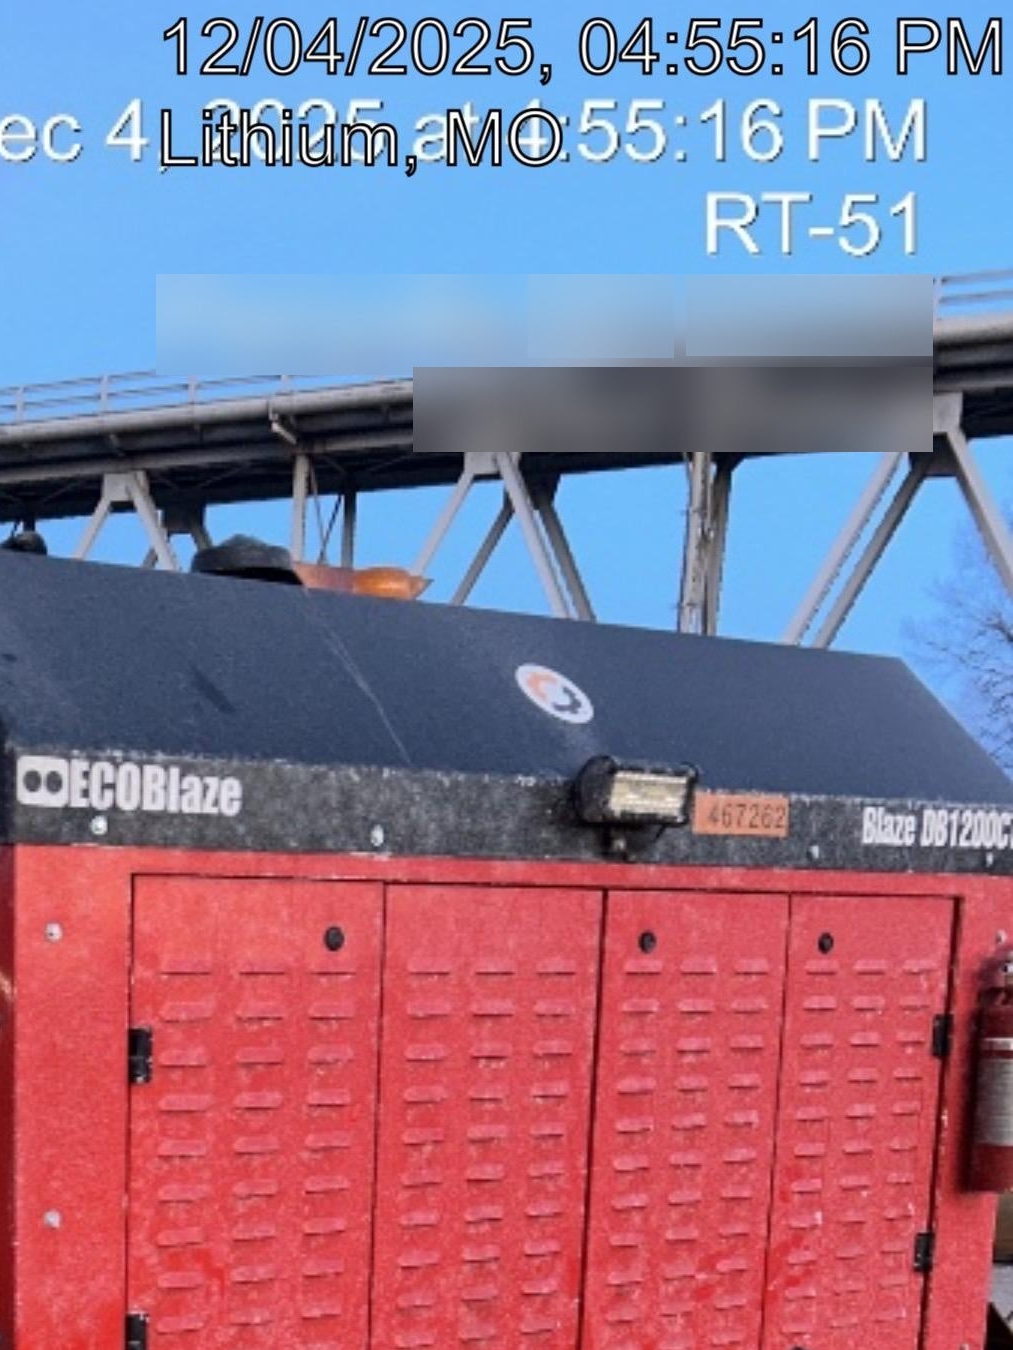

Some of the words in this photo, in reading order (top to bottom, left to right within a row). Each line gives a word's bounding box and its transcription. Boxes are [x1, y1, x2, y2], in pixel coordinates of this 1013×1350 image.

[69, 758, 243, 817] ECOBlaze
[708, 802, 787, 831] 467262
[861, 805, 918, 847] Blaze
